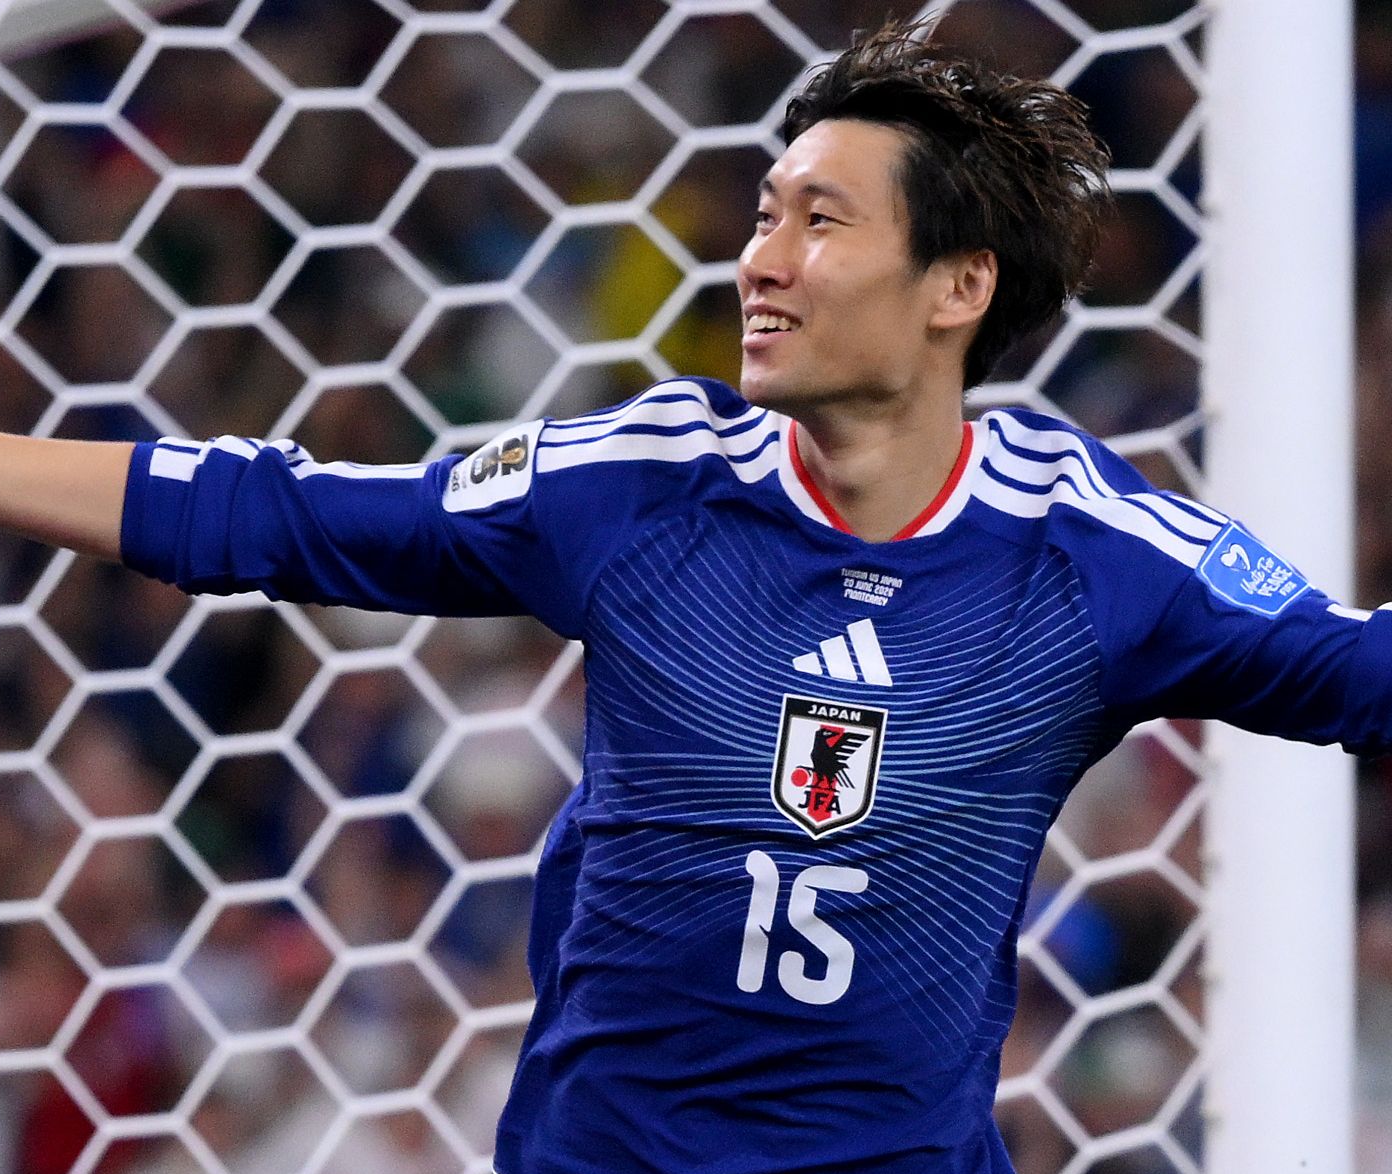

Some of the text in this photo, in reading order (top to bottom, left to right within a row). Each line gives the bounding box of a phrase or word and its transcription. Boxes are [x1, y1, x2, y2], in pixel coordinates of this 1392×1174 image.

[874, 583, 894, 597] 2026
[1257, 565, 1292, 597] PEACE
[807, 704, 861, 722] JAPAN
[797, 790, 842, 815] JFA
[736, 850, 869, 1005] 15
